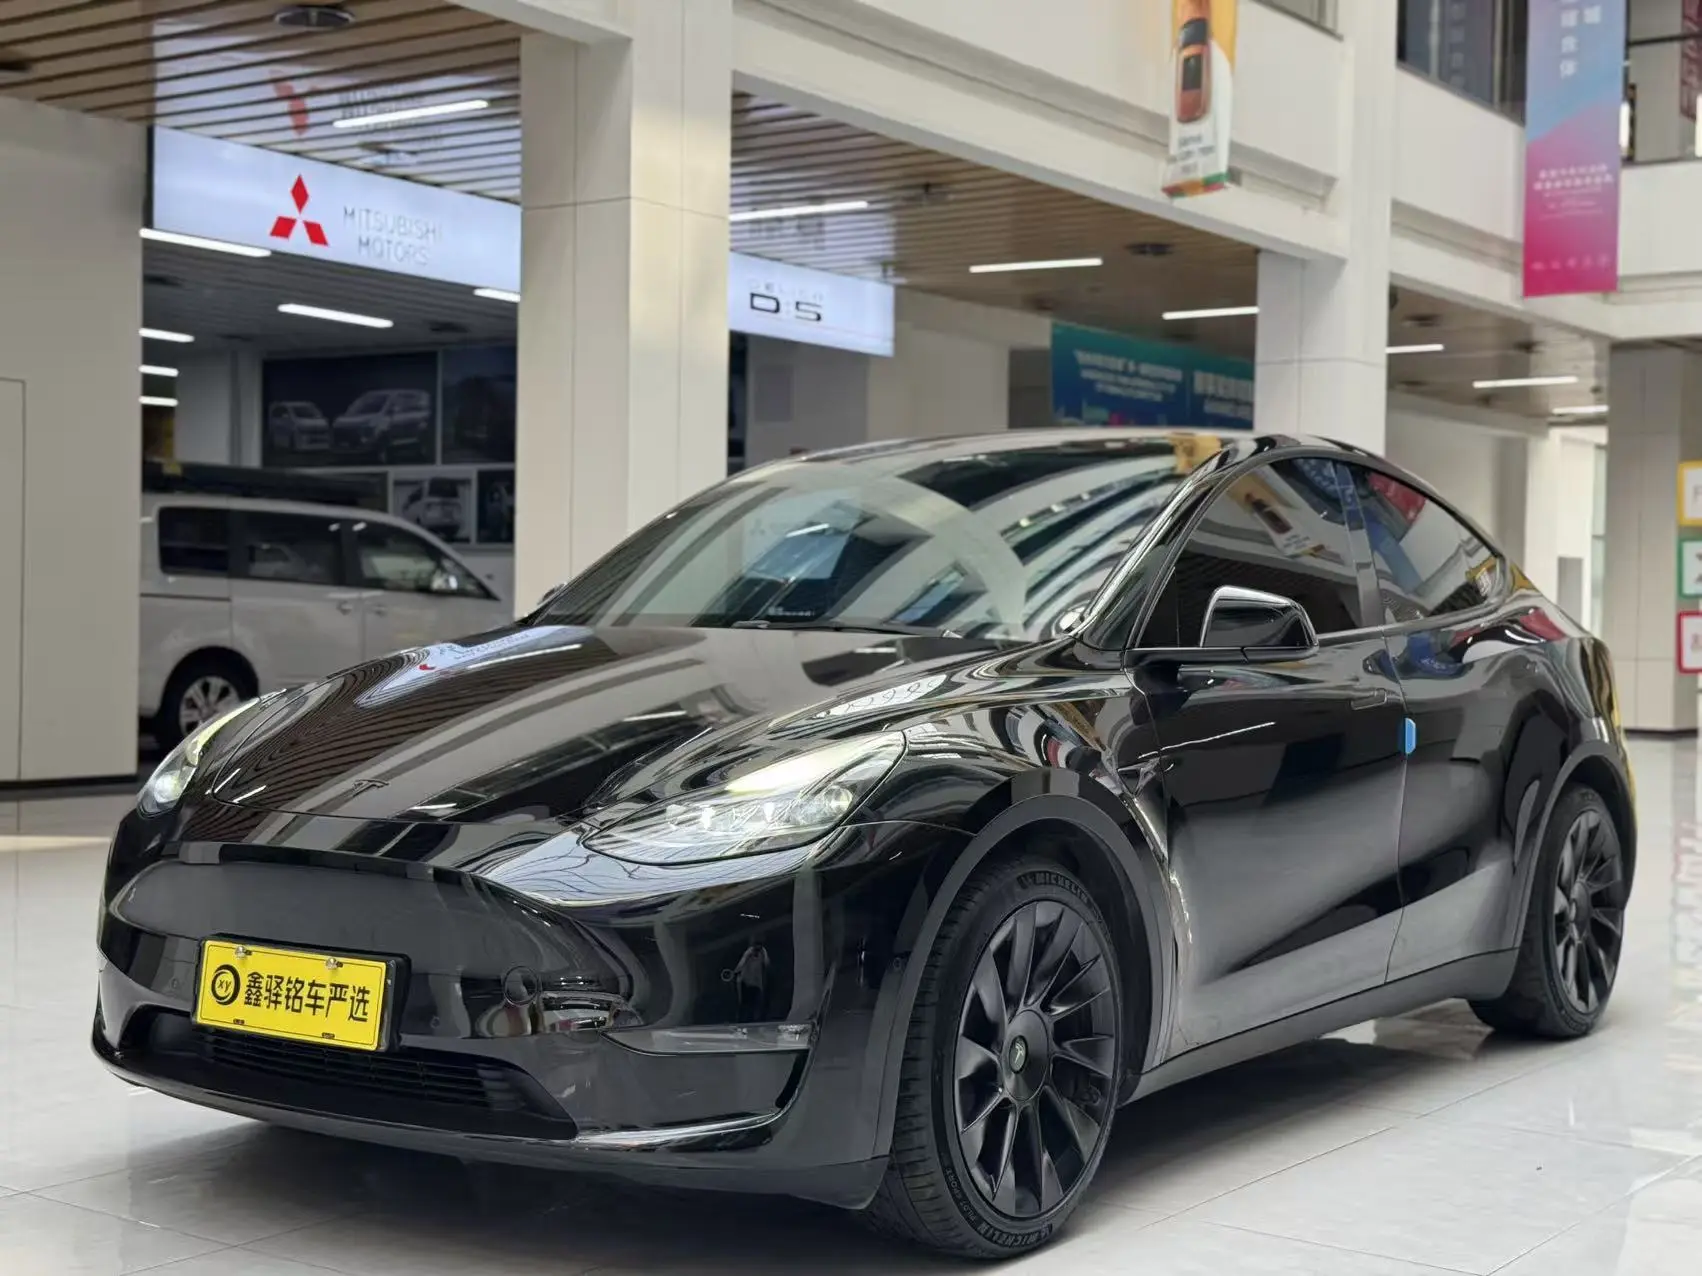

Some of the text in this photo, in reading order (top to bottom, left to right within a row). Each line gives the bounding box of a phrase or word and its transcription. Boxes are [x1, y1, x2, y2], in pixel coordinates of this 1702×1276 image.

[344, 207, 441, 242] MITSUBISHI
[358, 236, 429, 265] MOTORS
[1036, 872, 1088, 903] MICHELIN
[244, 971, 370, 1023] 鑫驿铭车严选
[979, 1223, 1039, 1246] MICHELIN
